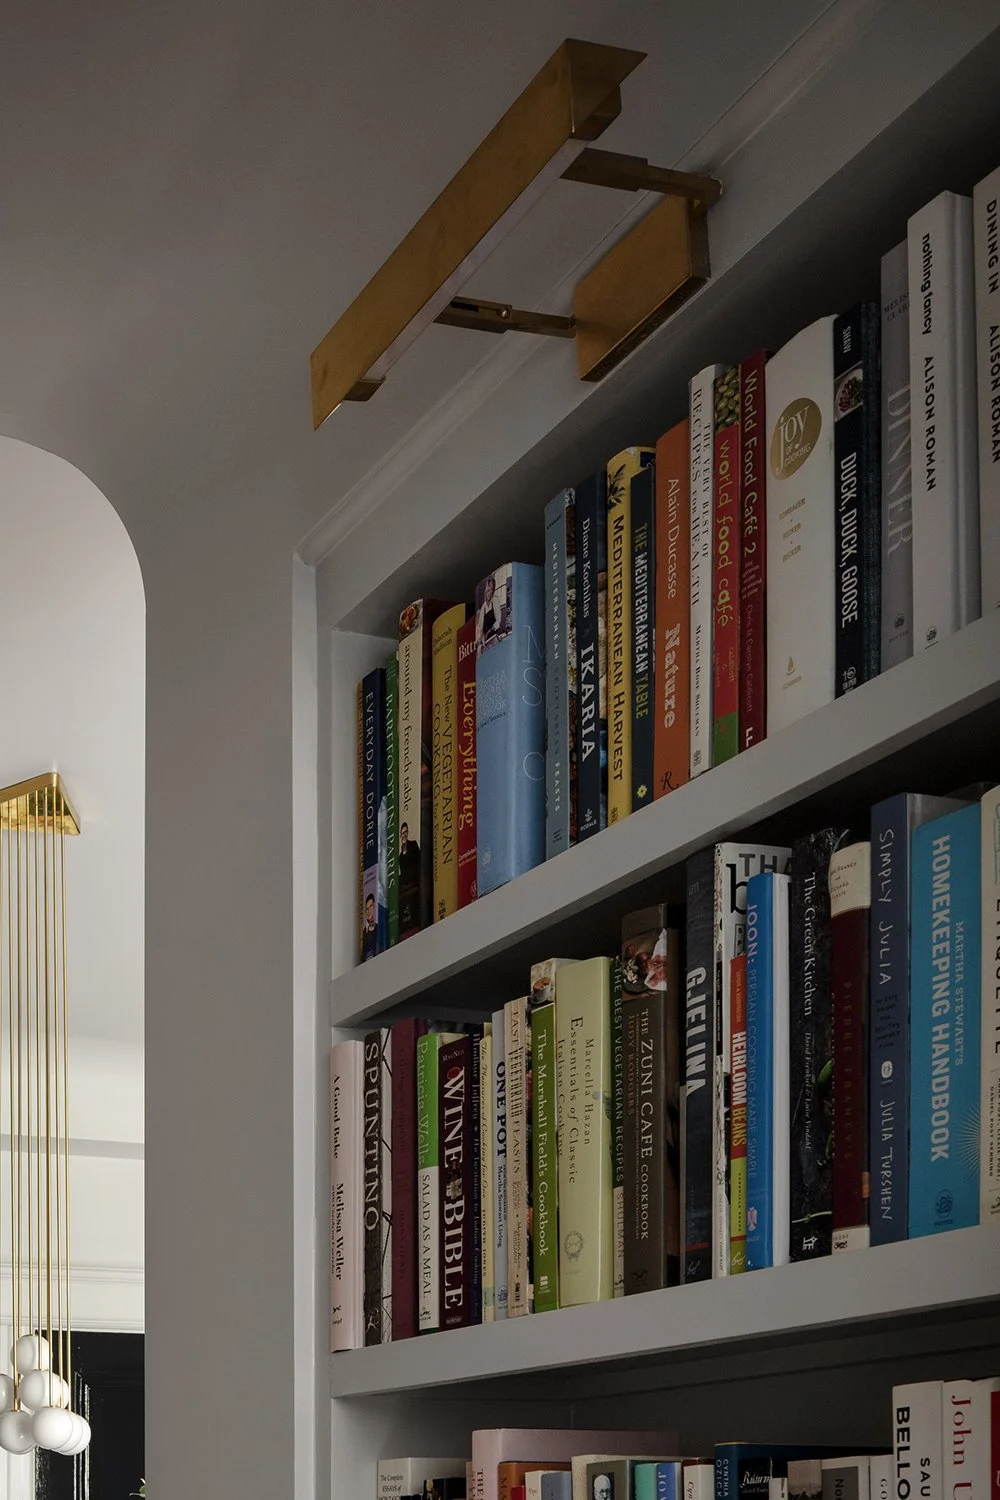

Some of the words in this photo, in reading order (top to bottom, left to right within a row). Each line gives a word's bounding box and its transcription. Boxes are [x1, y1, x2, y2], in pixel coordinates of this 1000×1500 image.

[921, 233, 933, 292] nothing
[922, 292, 934, 335] fancy
[743, 370, 757, 433] World
[923, 356, 935, 422] ALISON
[743, 437, 757, 487] Food
[775, 405, 810, 476] joy
[923, 425, 935, 492] ROMAN
[667, 479, 680, 524] Alain
[717, 440, 732, 508] world
[838, 452, 858, 512] DUCK,
[581, 518, 591, 559] Diane
[635, 523, 648, 552] THE
[716, 515, 733, 570] food
[743, 492, 758, 538] Café
[838, 508, 858, 568] DUCK,
[667, 526, 680, 599] Ducasse
[744, 542, 756, 558] 2
[581, 561, 591, 618] Kochilas
[612, 515, 625, 686] MEDITERRANEAN
[635, 552, 649, 674] MEDITERRANEAN
[716, 578, 732, 627] café
[840, 565, 858, 628] GOOSE
[580, 643, 595, 761] IKARIA
[634, 675, 648, 719] TABLE
[663, 623, 681, 728] Nature
[365, 691, 375, 782] EVERYDAY
[459, 681, 477, 830] Everything
[612, 691, 625, 781] HARVEST
[365, 791, 374, 849] DORIE
[877, 829, 894, 904] SIMPLY
[878, 920, 893, 985] JULIA
[930, 835, 951, 1018] HOMEKEEPING
[537, 1029, 548, 1061] The
[686, 967, 708, 1099] GJELINA
[496, 1061, 506, 1110] ONE
[537, 1064, 548, 1127] Marshall
[731, 1031, 747, 1105] HEIRLOOM
[930, 1023, 951, 1163] HANDBOOK
[364, 1042, 380, 1231] SPUNTINO
[443, 1067, 466, 1169] WINE
[496, 1115, 507, 1158] POT
[732, 1106, 747, 1147] BEANS
[880, 1100, 895, 1141] JULIA
[537, 1133, 548, 1179] Field's
[880, 1147, 894, 1220] TURSHEN
[537, 1182, 549, 1257] Cookbook
[443, 1195, 466, 1310] BIBLE
[951, 1395, 972, 1465] John
